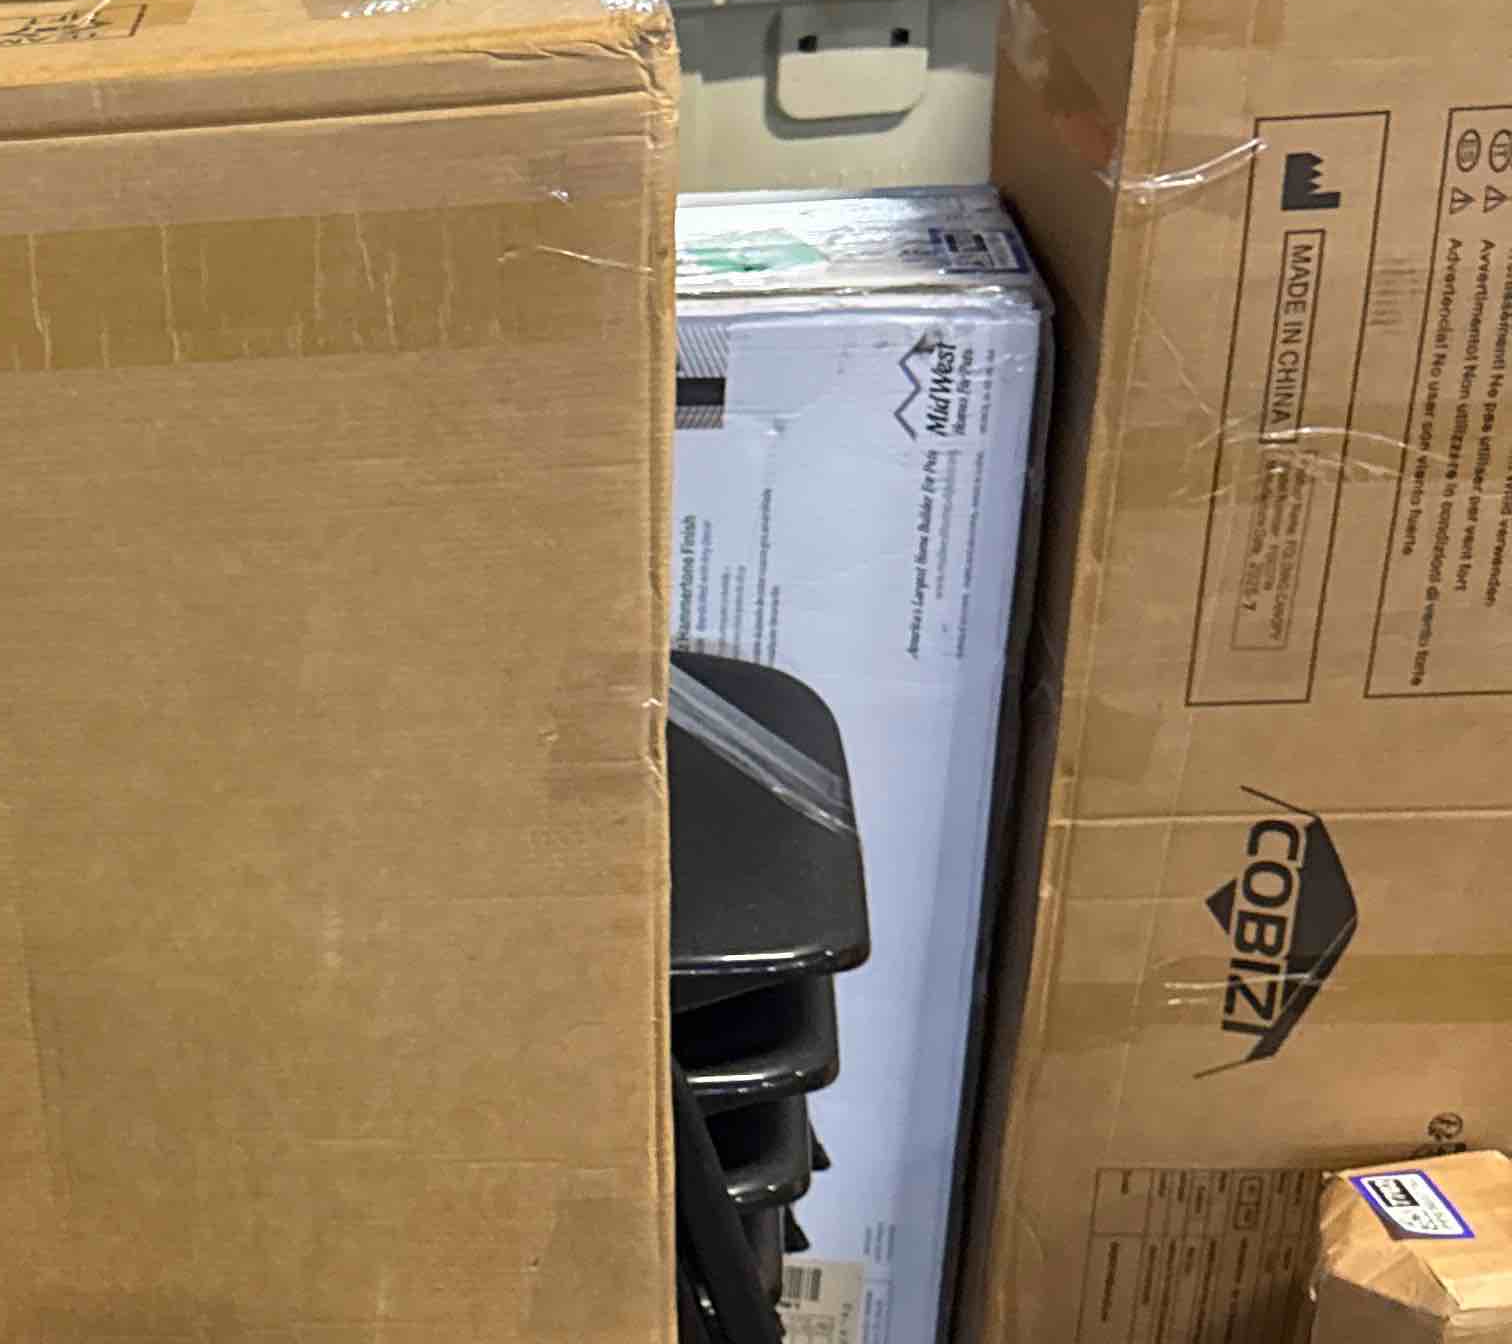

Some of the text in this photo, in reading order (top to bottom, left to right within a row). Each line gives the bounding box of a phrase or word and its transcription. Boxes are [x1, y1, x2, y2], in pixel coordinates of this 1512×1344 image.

[1284, 244, 1313, 316] MADE
[1278, 321, 1302, 344] IN
[925, 342, 956, 437] MidWest
[1270, 350, 1298, 425] CHINA
[681, 515, 696, 554] Finish
[1221, 820, 1299, 1036] COBIZI
